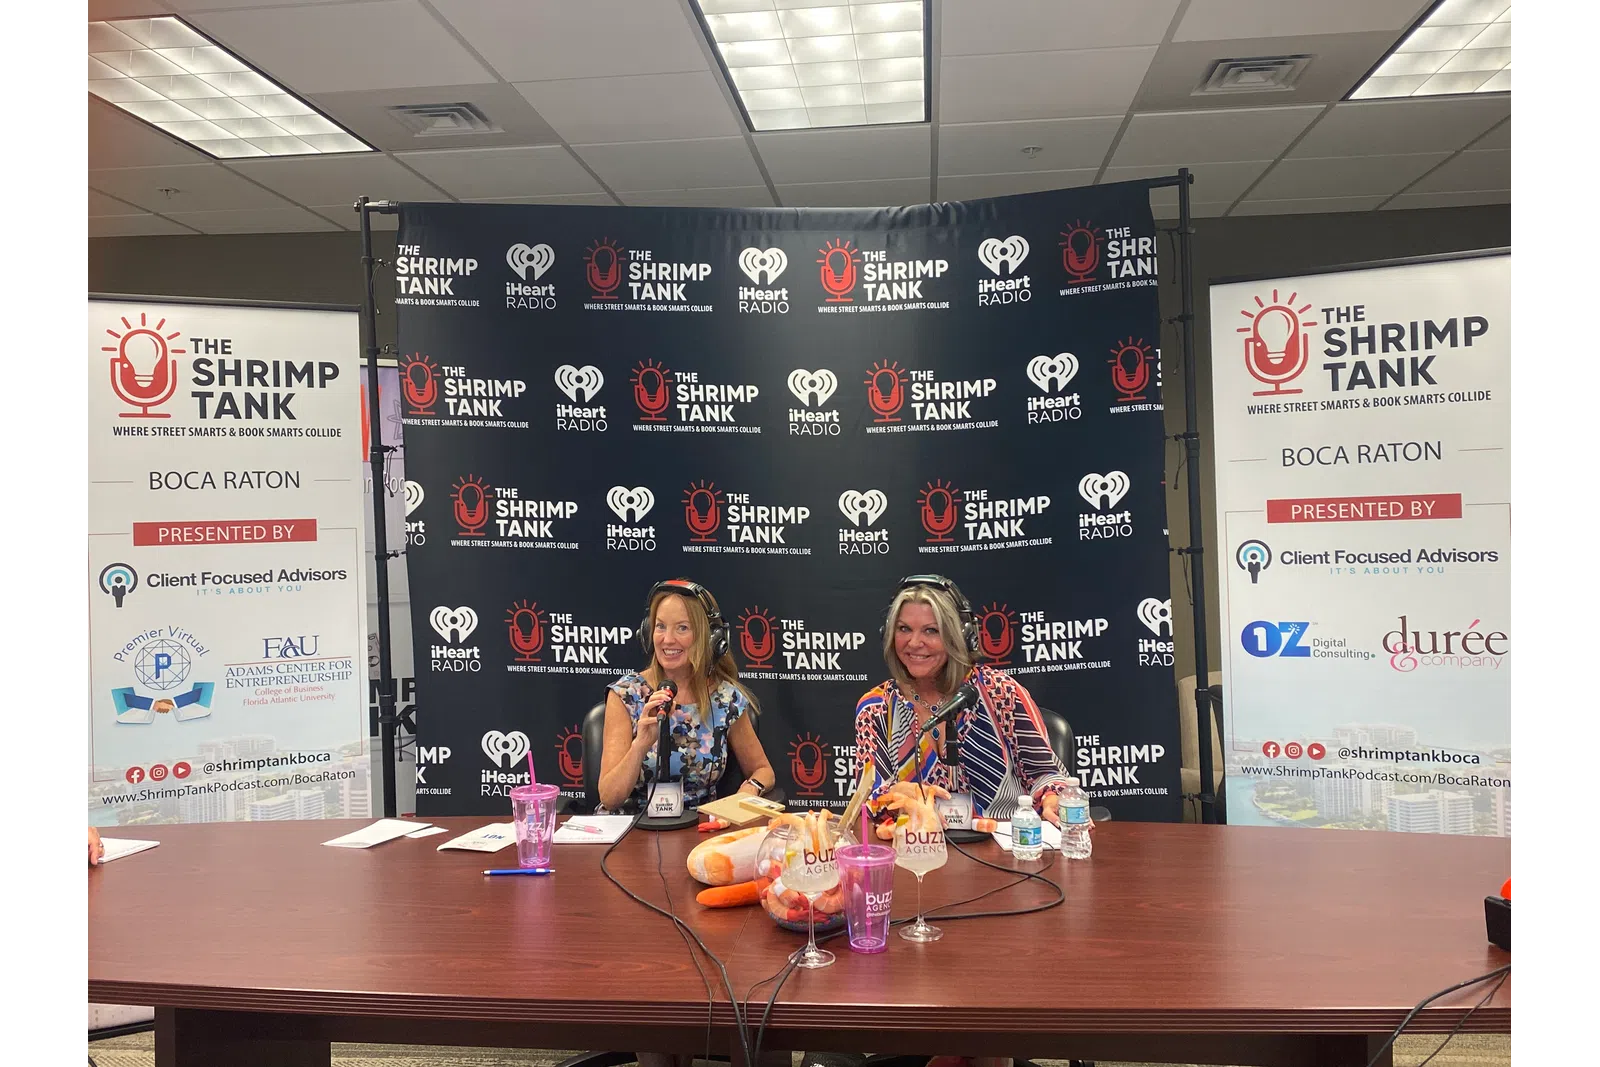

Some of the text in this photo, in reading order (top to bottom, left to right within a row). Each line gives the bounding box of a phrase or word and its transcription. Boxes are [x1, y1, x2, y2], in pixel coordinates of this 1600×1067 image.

[398, 245, 420, 255] THE
[629, 250, 651, 261] THE
[863, 251, 886, 261] THE
[396, 257, 478, 275] SHRIMP
[629, 263, 711, 281] SHRIMP
[864, 260, 948, 281] SHRIMP
[397, 277, 454, 295] TANK
[506, 282, 555, 296] iHeart
[629, 283, 687, 301] TANK
[863, 280, 923, 301] TANK
[979, 275, 1030, 293] iHeart
[739, 287, 788, 300] iHeart
[979, 289, 1031, 306] RADIO
[507, 297, 556, 309] RADIO
[739, 301, 789, 314] RADIO
[1321, 305, 1365, 324] THE
[1324, 316, 1489, 357] SHRIMP
[190, 338, 232, 354] THE
[192, 358, 339, 388] SHRIMP
[442, 366, 465, 377] THE
[910, 371, 933, 381] THE
[1323, 356, 1437, 391] TANK
[445, 378, 526, 398] SHRIMP
[911, 379, 996, 400] SHRIMP
[191, 392, 296, 420] TANK
[445, 398, 503, 417] TANK
[911, 401, 971, 420] TANK
[1028, 393, 1080, 411] iHeart
[1247, 391, 1491, 415] WHERE STREET SMARTS & BOOK SMARTS COLLIDE
[557, 404, 606, 418] iHeart
[789, 408, 839, 422] iHeart
[1028, 407, 1081, 424] RADIO
[113, 426, 341, 438] WHERE STREET SMARTS & BOOK SMARTS COLLIDE
[557, 419, 607, 432] RADIO
[789, 424, 840, 435] RADIO
[953, 422, 975, 430] SMARTS
[976, 420, 998, 428] COLLIDE
[1282, 441, 1441, 467] BOCA RATON
[149, 471, 300, 490] BOCA RATON
[727, 493, 749, 504] THE
[964, 490, 987, 501] THE
[728, 506, 810, 524] SHRIMP
[965, 496, 1050, 521] SHRIMP
[1291, 501, 1436, 519] PRESENTED BY
[1079, 511, 1131, 528] iHeart
[159, 525, 294, 542] PRESENTED BY
[607, 524, 655, 539] iHeart
[728, 526, 785, 544] TANK
[839, 529, 888, 542] iHeart
[964, 519, 1025, 541] TANK
[1080, 525, 1133, 541] RADIO
[607, 539, 656, 551] RADIO
[839, 543, 889, 555] RADIO
[1280, 548, 1498, 565] Client Focused Advisors
[147, 568, 347, 588] Client Focused Advisors
[197, 588, 222, 596] IT'S
[229, 586, 270, 594] ABOUT
[1020, 611, 1044, 622] THE
[1022, 618, 1108, 643] SHRIMP
[1382, 616, 1508, 655] durée
[113, 626, 210, 663] Premier Virtual
[262, 635, 320, 659] FAU
[431, 645, 480, 659] iHeart
[1022, 641, 1083, 663] TANK
[1313, 638, 1346, 649] Digital
[225, 660, 352, 677] ADAMS CENTER FOR
[432, 659, 481, 672] RADIO
[1018, 665, 1040, 674] SMARTS
[1047, 664, 1063, 672] BOOK
[1064, 663, 1087, 671] SMARTS
[1088, 661, 1110, 669] COLLIDE
[1421, 655, 1503, 669] company
[226, 671, 352, 689] ENTREPRENEURSHIP
[255, 684, 323, 696] College of Business
[243, 693, 336, 707] Florida Atlantic University
[1075, 735, 1100, 746] THE
[203, 752, 330, 775] @shrimptankboca
[1077, 745, 1165, 766] SHRIMP
[1338, 747, 1480, 764] @shrimptankboca
[481, 770, 530, 784] iHeart
[1077, 766, 1139, 787] TANK
[1241, 766, 1510, 787] www.ShrimpTankPodcast.com/BocaRaton
[102, 770, 355, 805] www.ShrimpTankPodcast.com/BocaRaton
[906, 829, 944, 844] buzz
[804, 847, 836, 865] buz
